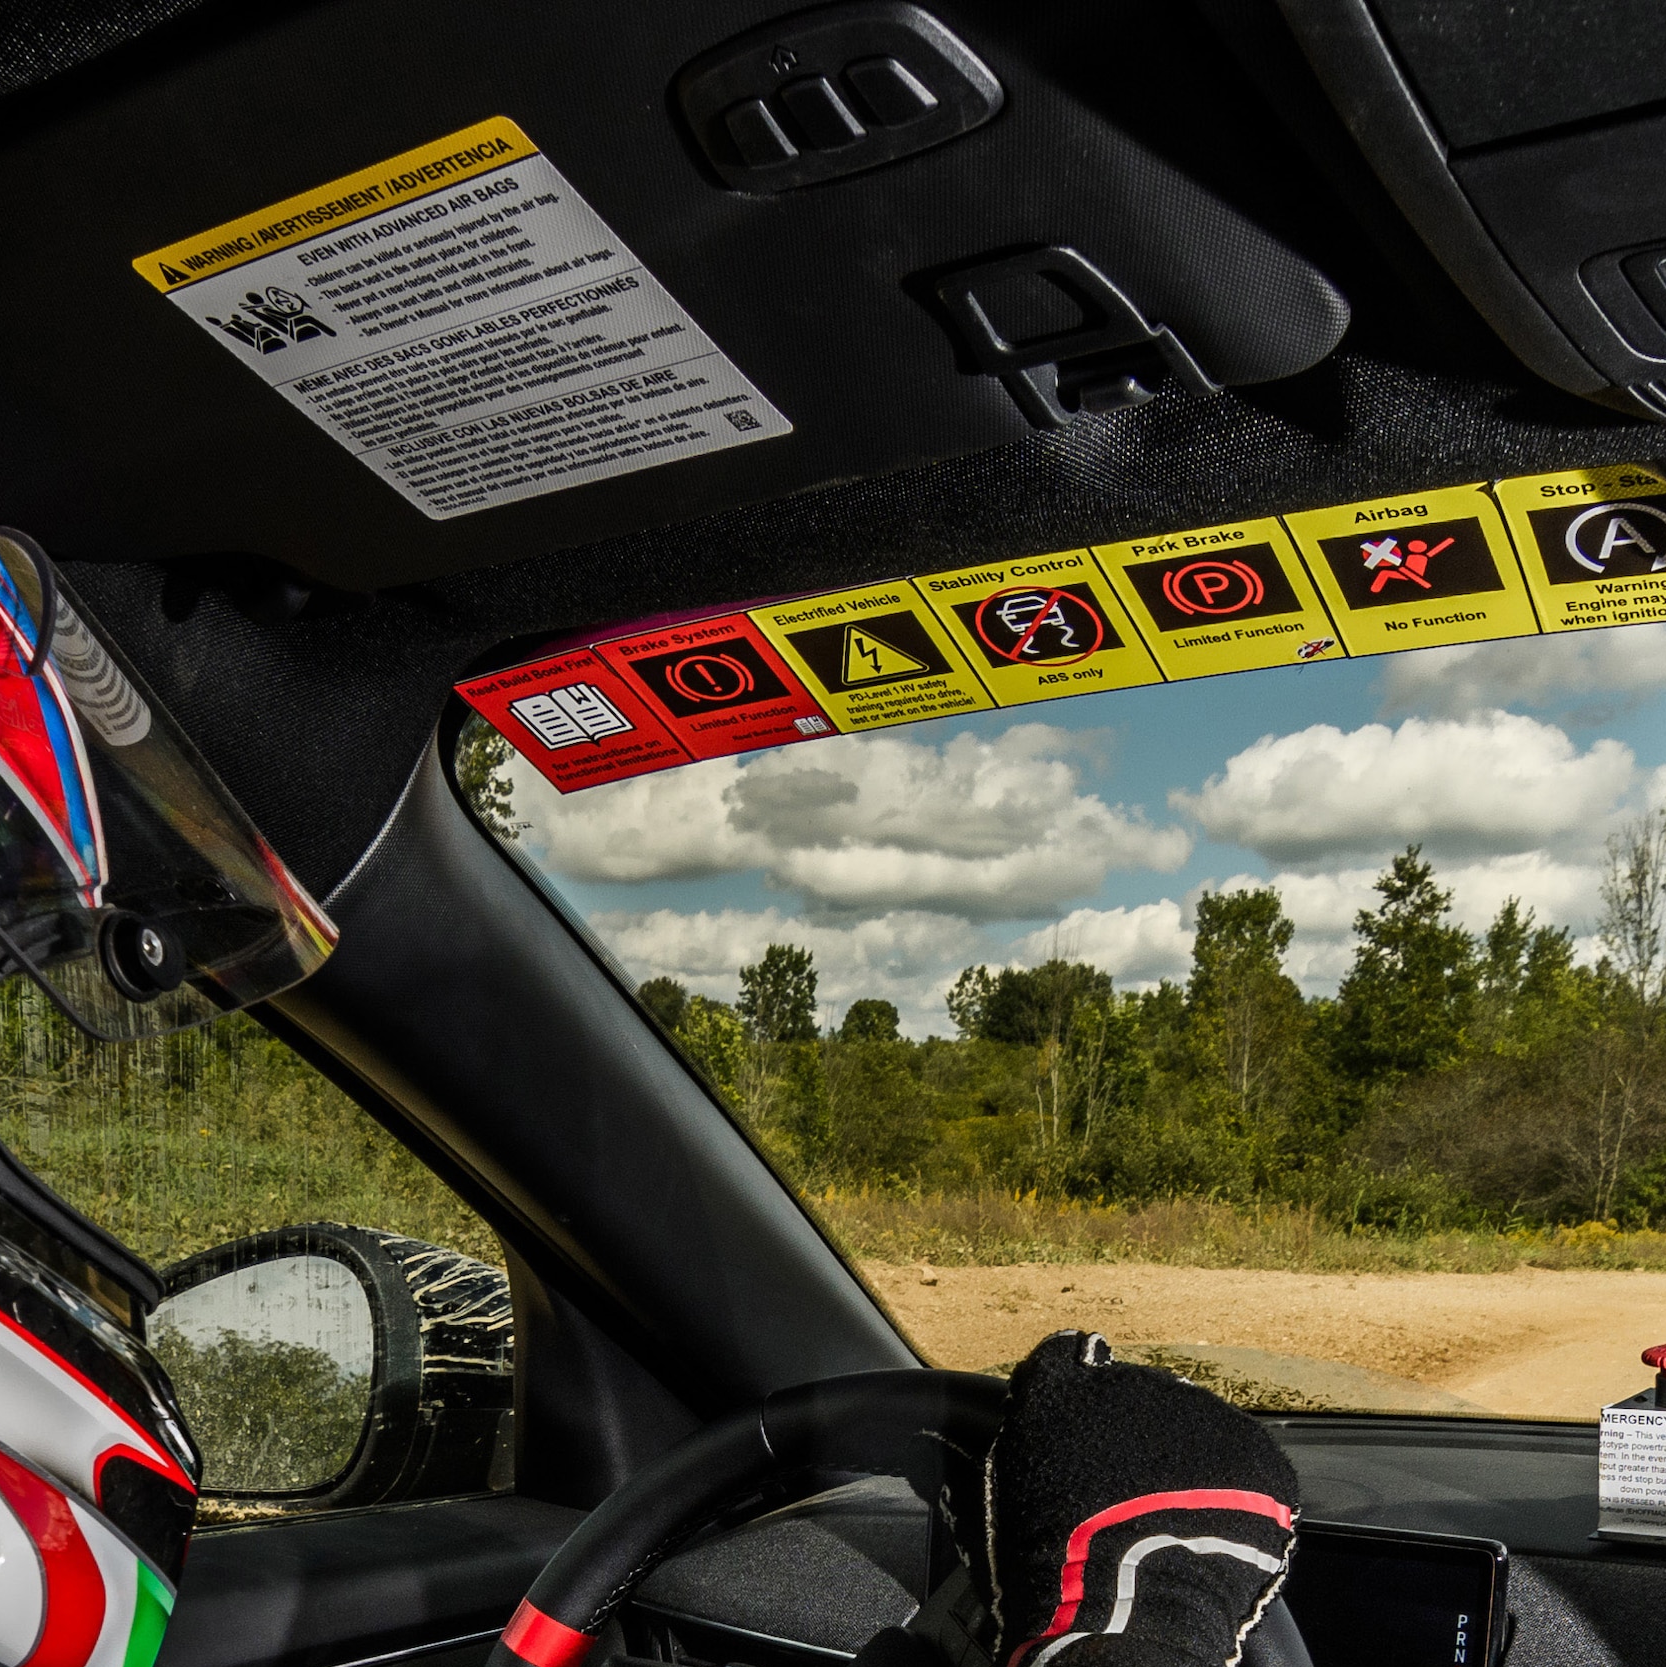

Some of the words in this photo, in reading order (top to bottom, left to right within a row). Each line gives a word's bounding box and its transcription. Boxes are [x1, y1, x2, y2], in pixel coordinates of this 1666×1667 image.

[296, 244, 339, 267] EVEN
[333, 231, 375, 253] WITH
[371, 203, 449, 241] ADVANCED
[447, 193, 477, 213] AIR
[472, 177, 520, 203] BAGS
[307, 268, 348, 287] Children
[344, 262, 366, 275] can
[360, 258, 378, 269] be
[373, 246, 404, 264] killed
[401, 244, 415, 254] or
[412, 228, 457, 251] seriously
[452, 214, 491, 236] injured
[486, 211, 505, 223] by
[500, 205, 522, 218] the
[519, 199, 536, 212] air
[533, 192, 560, 207] bag.
[179, 236, 256, 272] WARNING
[331, 363, 368, 383] AVEC
[363, 354, 396, 371] DES
[392, 342, 432, 362] SACS
[429, 314, 522, 350] GONFLABLES
[518, 276, 640, 323] PERFECTIONNÉS
[387, 431, 456, 458] INCLUSIVE
[451, 423, 484, 439] CON
[480, 416, 511, 432] LAS
[507, 401, 565, 424] NUEVAS
[561, 385, 621, 409] BOLSAS
[618, 378, 644, 393] DE
[641, 368, 678, 388] AIRE
[1539, 476, 1602, 498] Stop
[1618, 468, 1659, 488] Sta
[1354, 504, 1429, 524] Airbag
[1131, 540, 1181, 557] Park
[1182, 530, 1245, 548] Brake
[928, 571, 1005, 592] Stability
[1009, 555, 1084, 577] Control
[772, 602, 847, 626] Electrified
[845, 593, 901, 611] Vehicle
[1565, 598, 1628, 612] Engine
[1384, 620, 1409, 632] No
[1411, 611, 1487, 628] Function
[1560, 614, 1608, 626] when
[618, 639, 669, 656] Brake
[670, 624, 736, 644] System
[1172, 631, 1232, 649] Limited
[1233, 622, 1305, 640] Function
[465, 682, 500, 698] Read
[497, 672, 533, 689] Build
[530, 664, 567, 680] Book
[563, 655, 596, 671] First
[1038, 672, 1070, 686] ABS
[1072, 667, 1103, 680] only
[846, 702, 885, 715] training
[884, 693, 926, 708] required
[924, 692, 937, 701] to
[936, 688, 967, 699] drive,
[847, 687, 893, 703] PD-Level
[892, 686, 900, 695] 1
[899, 683, 916, 694] HV
[916, 679, 948, 691] safety
[689, 715, 740, 733] Limited
[738, 705, 798, 723] Function
[849, 715, 871, 726] test
[869, 713, 881, 722] or
[880, 708, 907, 720] work
[906, 707, 921, 715] on
[919, 704, 938, 713] the
[937, 696, 977, 710] vehicle!
[1457, 1614, 1468, 1629] P
[1456, 1631, 1467, 1647] R
[1454, 1648, 1466, 1664] N
